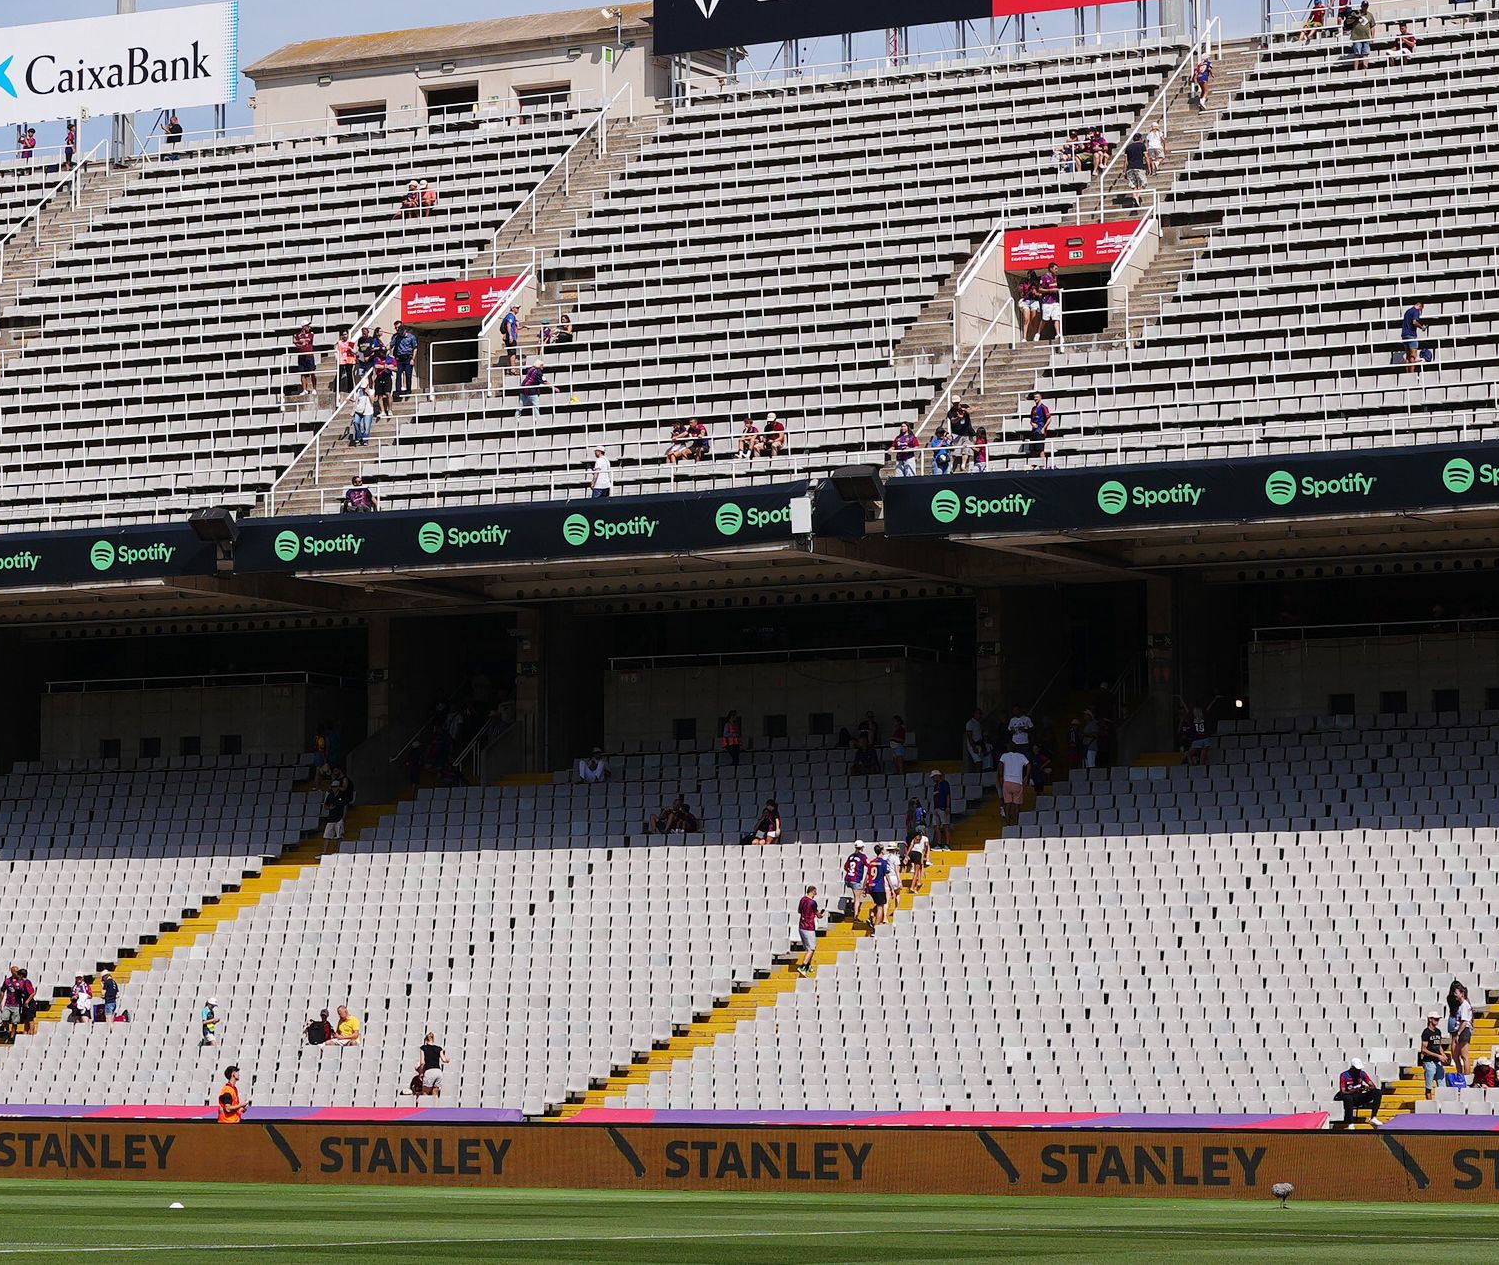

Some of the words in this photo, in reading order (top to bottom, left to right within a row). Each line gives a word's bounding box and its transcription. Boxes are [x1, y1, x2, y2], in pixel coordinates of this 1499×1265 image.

[25, 40, 212, 95] CaixaBank
[1133, 483, 1204, 506] Spotify
[1302, 473, 1377, 498] Spotify
[965, 494, 1034, 516] Spotify
[448, 526, 510, 545] Spotify
[595, 516, 655, 538] Spotify
[119, 543, 174, 564] Spotify
[304, 534, 364, 555] Spotify
[320, 1137, 511, 1175] STANLEY
[665, 1140, 872, 1180] STANLEY
[1041, 1144, 1266, 1186] STANLEY
